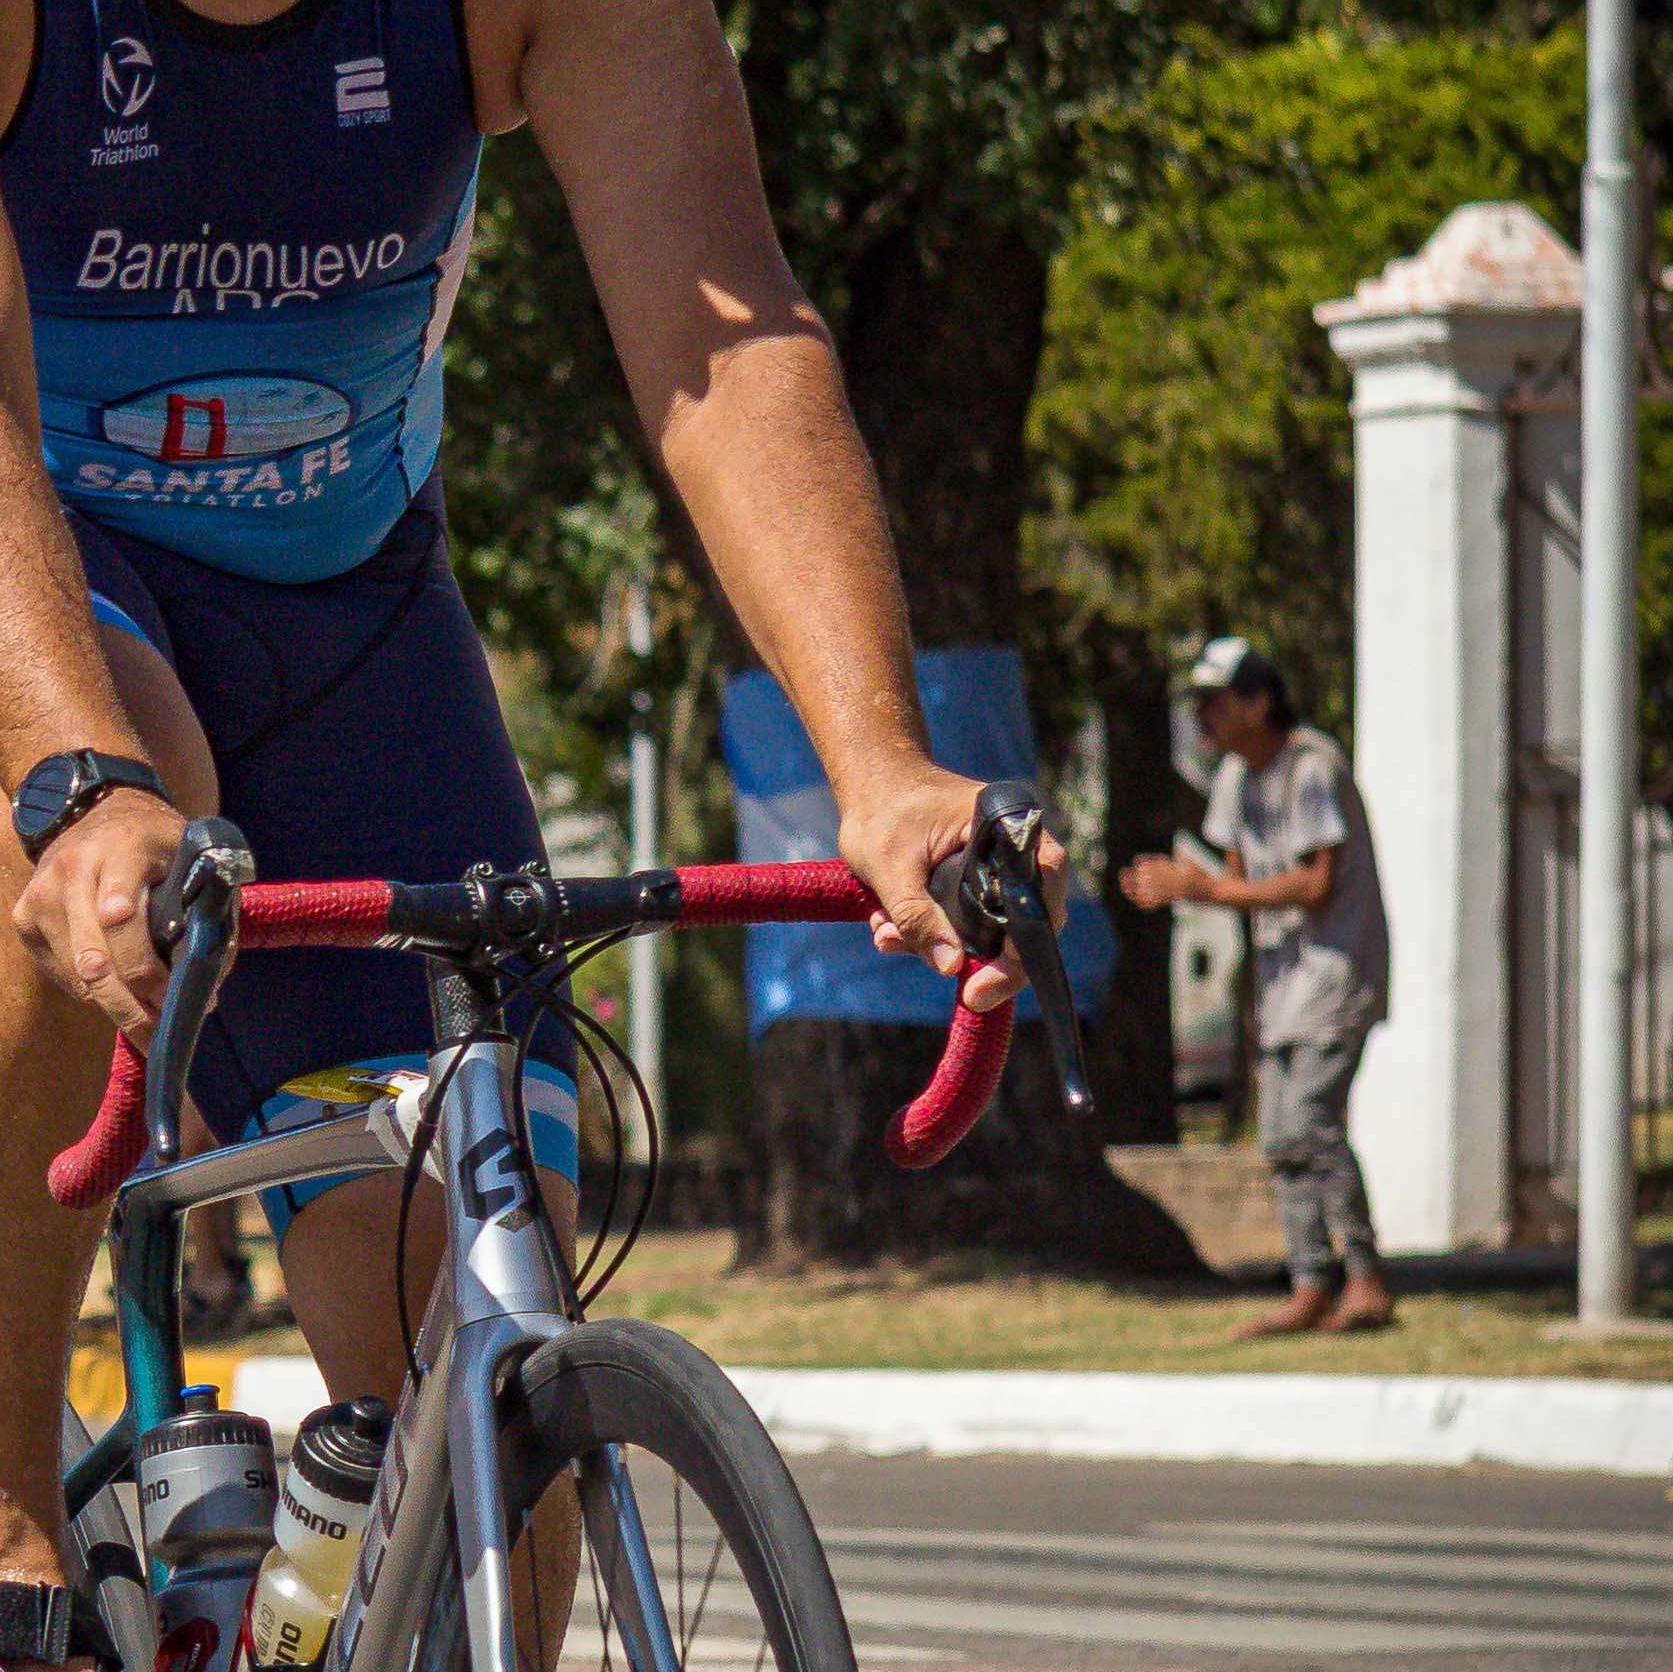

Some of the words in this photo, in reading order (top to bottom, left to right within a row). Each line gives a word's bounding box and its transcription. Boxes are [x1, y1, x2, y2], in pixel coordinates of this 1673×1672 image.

[90, 142, 160, 166] Triathlon
[103, 122, 149, 145] World
[76, 222, 405, 290] Barrionuevo
[74, 461, 283, 494] SANTA
[300, 434, 352, 486] FE
